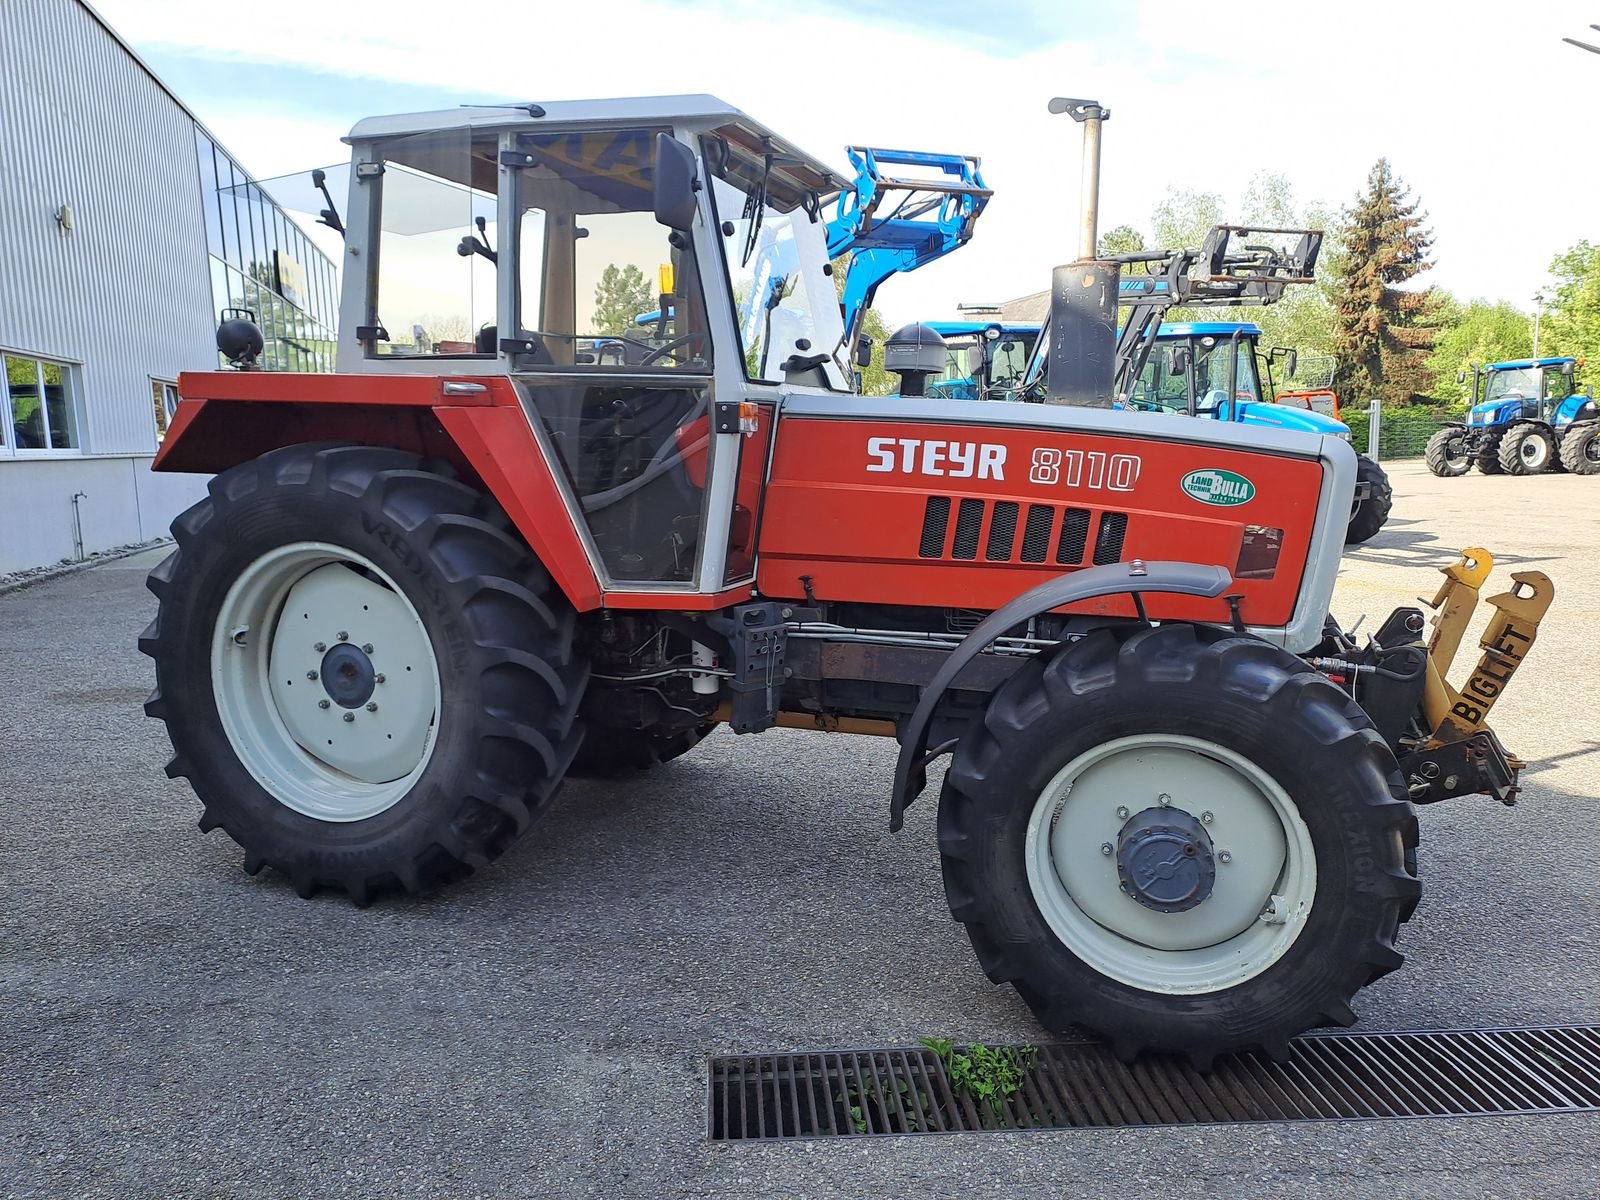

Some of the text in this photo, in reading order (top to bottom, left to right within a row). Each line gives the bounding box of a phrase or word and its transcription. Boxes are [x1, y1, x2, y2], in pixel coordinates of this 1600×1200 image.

[866, 437, 1142, 492] STEYR 8110
[1187, 484, 1212, 493] TECHNIK
[1191, 475, 1213, 487] LAND
[1211, 474, 1249, 499] BULLA
